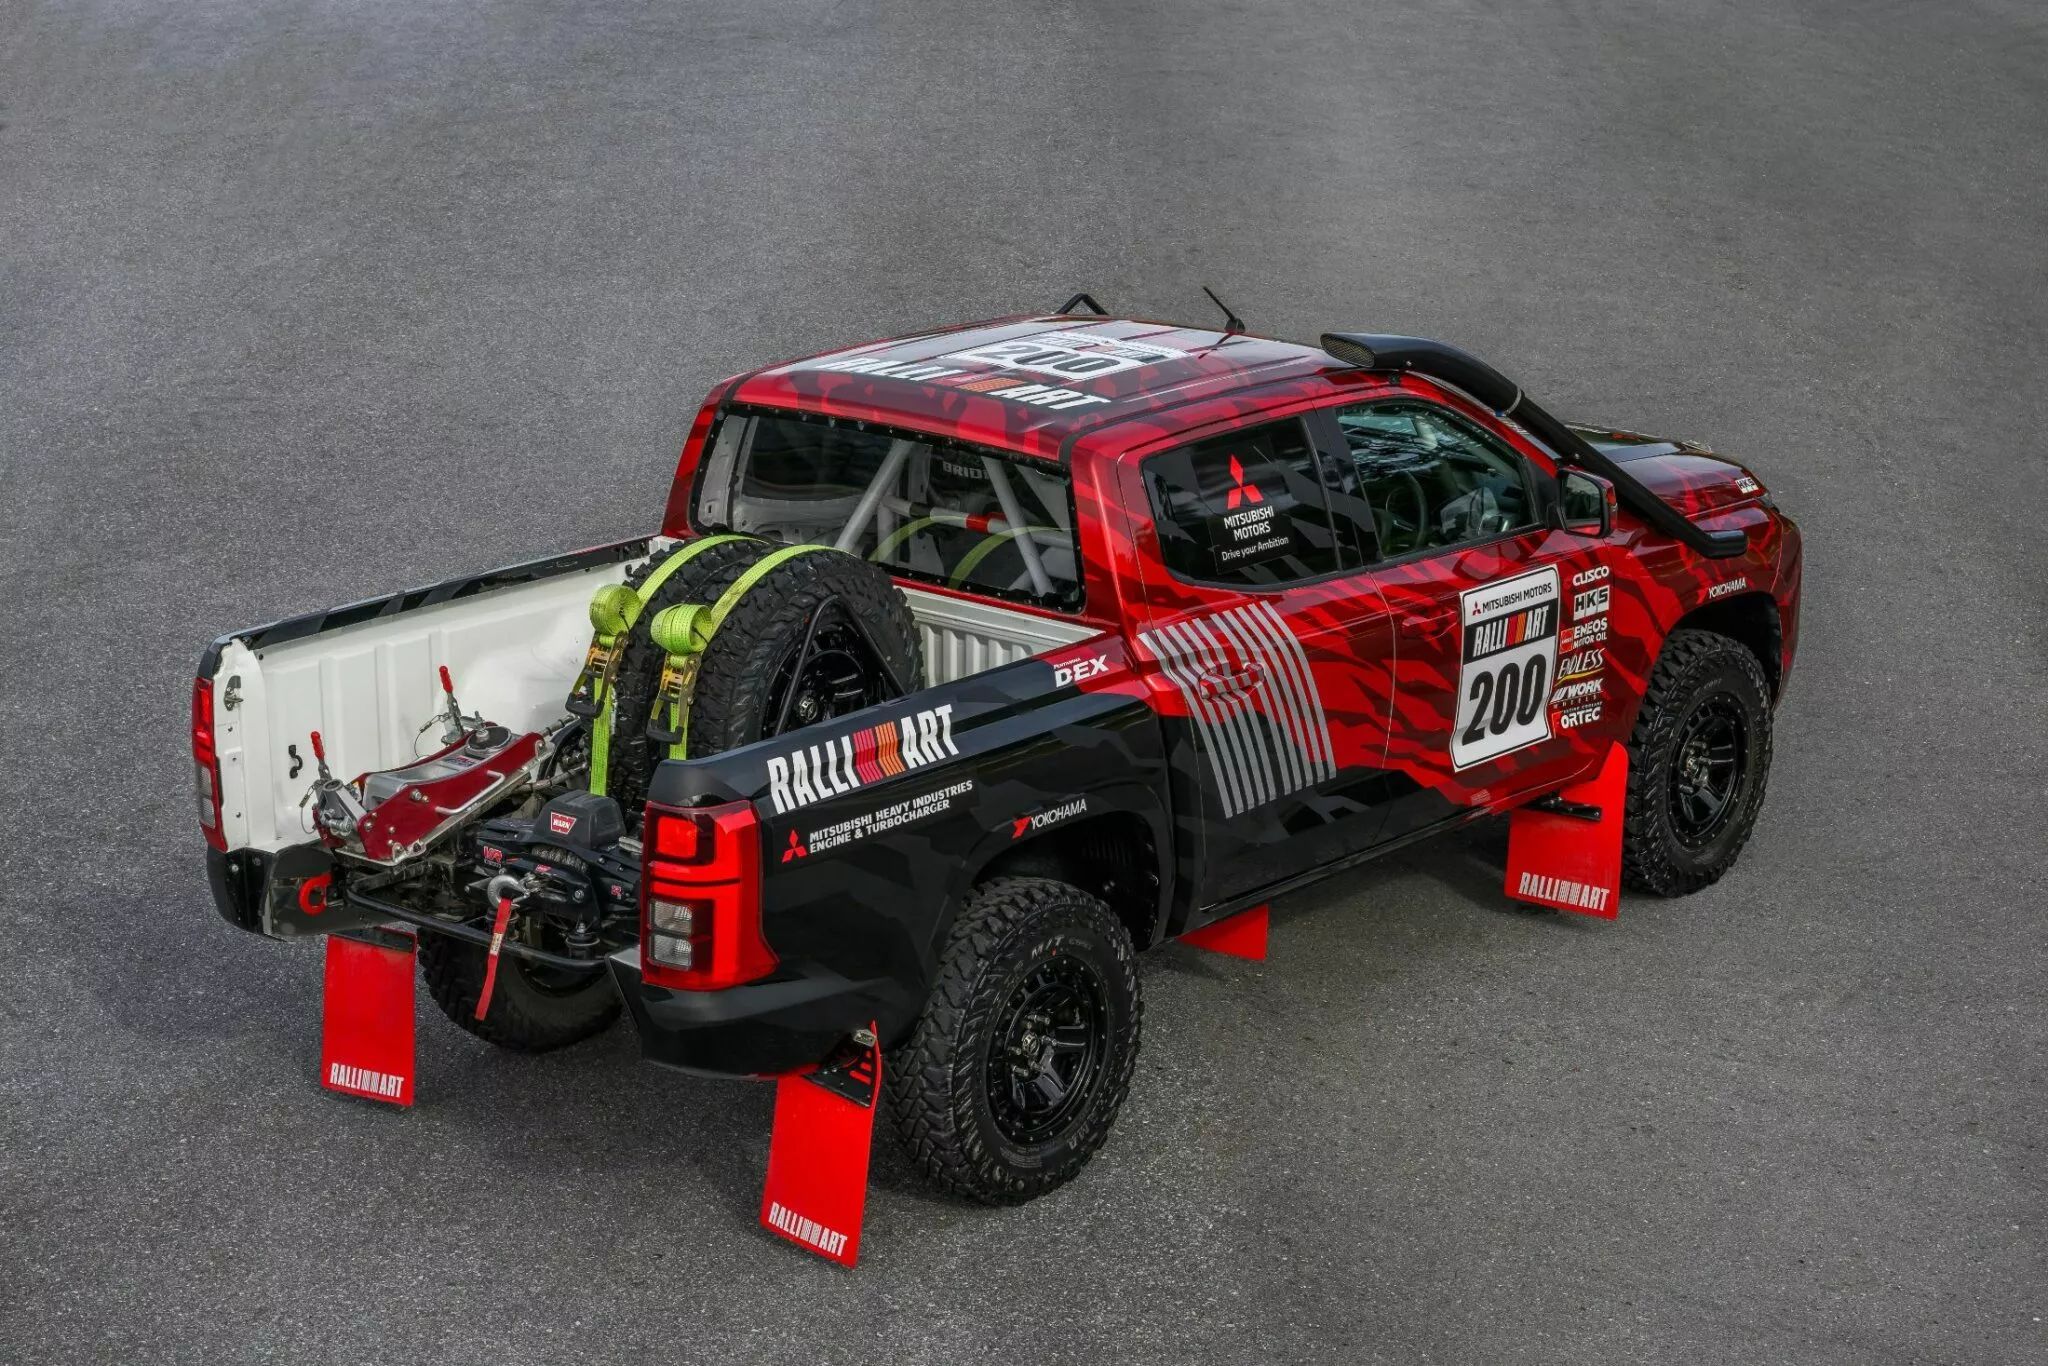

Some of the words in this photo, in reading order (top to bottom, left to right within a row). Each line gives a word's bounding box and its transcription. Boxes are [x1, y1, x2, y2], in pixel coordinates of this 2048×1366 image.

[974, 344, 1122, 373] 200
[1224, 506, 1275, 529] MITSUBISHI
[1233, 522, 1271, 541] MOTORS
[1222, 549, 1241, 561] Drive
[1241, 546, 1257, 559] your
[1258, 536, 1289, 552] Ambition
[1573, 565, 1609, 586] CUSCO
[1708, 577, 1746, 598] YOKOHAMA
[1482, 590, 1523, 613] MITSUBISHI
[1523, 582, 1552, 600] MOTORS
[1575, 587, 1609, 612] HKS
[1573, 635, 1595, 649] MOTOR
[1596, 631, 1607, 643] OIL
[1574, 617, 1608, 639] ENEOS
[1055, 654, 1109, 688] DEX
[1558, 647, 1606, 680] ENDLESS
[1462, 653, 1547, 746] 200
[809, 814, 873, 843] MITSUBISHI
[875, 800, 911, 822] HEAVY
[912, 779, 973, 809] INDUSTRIES
[1031, 798, 1087, 830] YOKOHAMA
[809, 831, 851, 853] ENGINE
[854, 828, 863, 839] &
[866, 799, 950, 835] TURBOCHARGER
